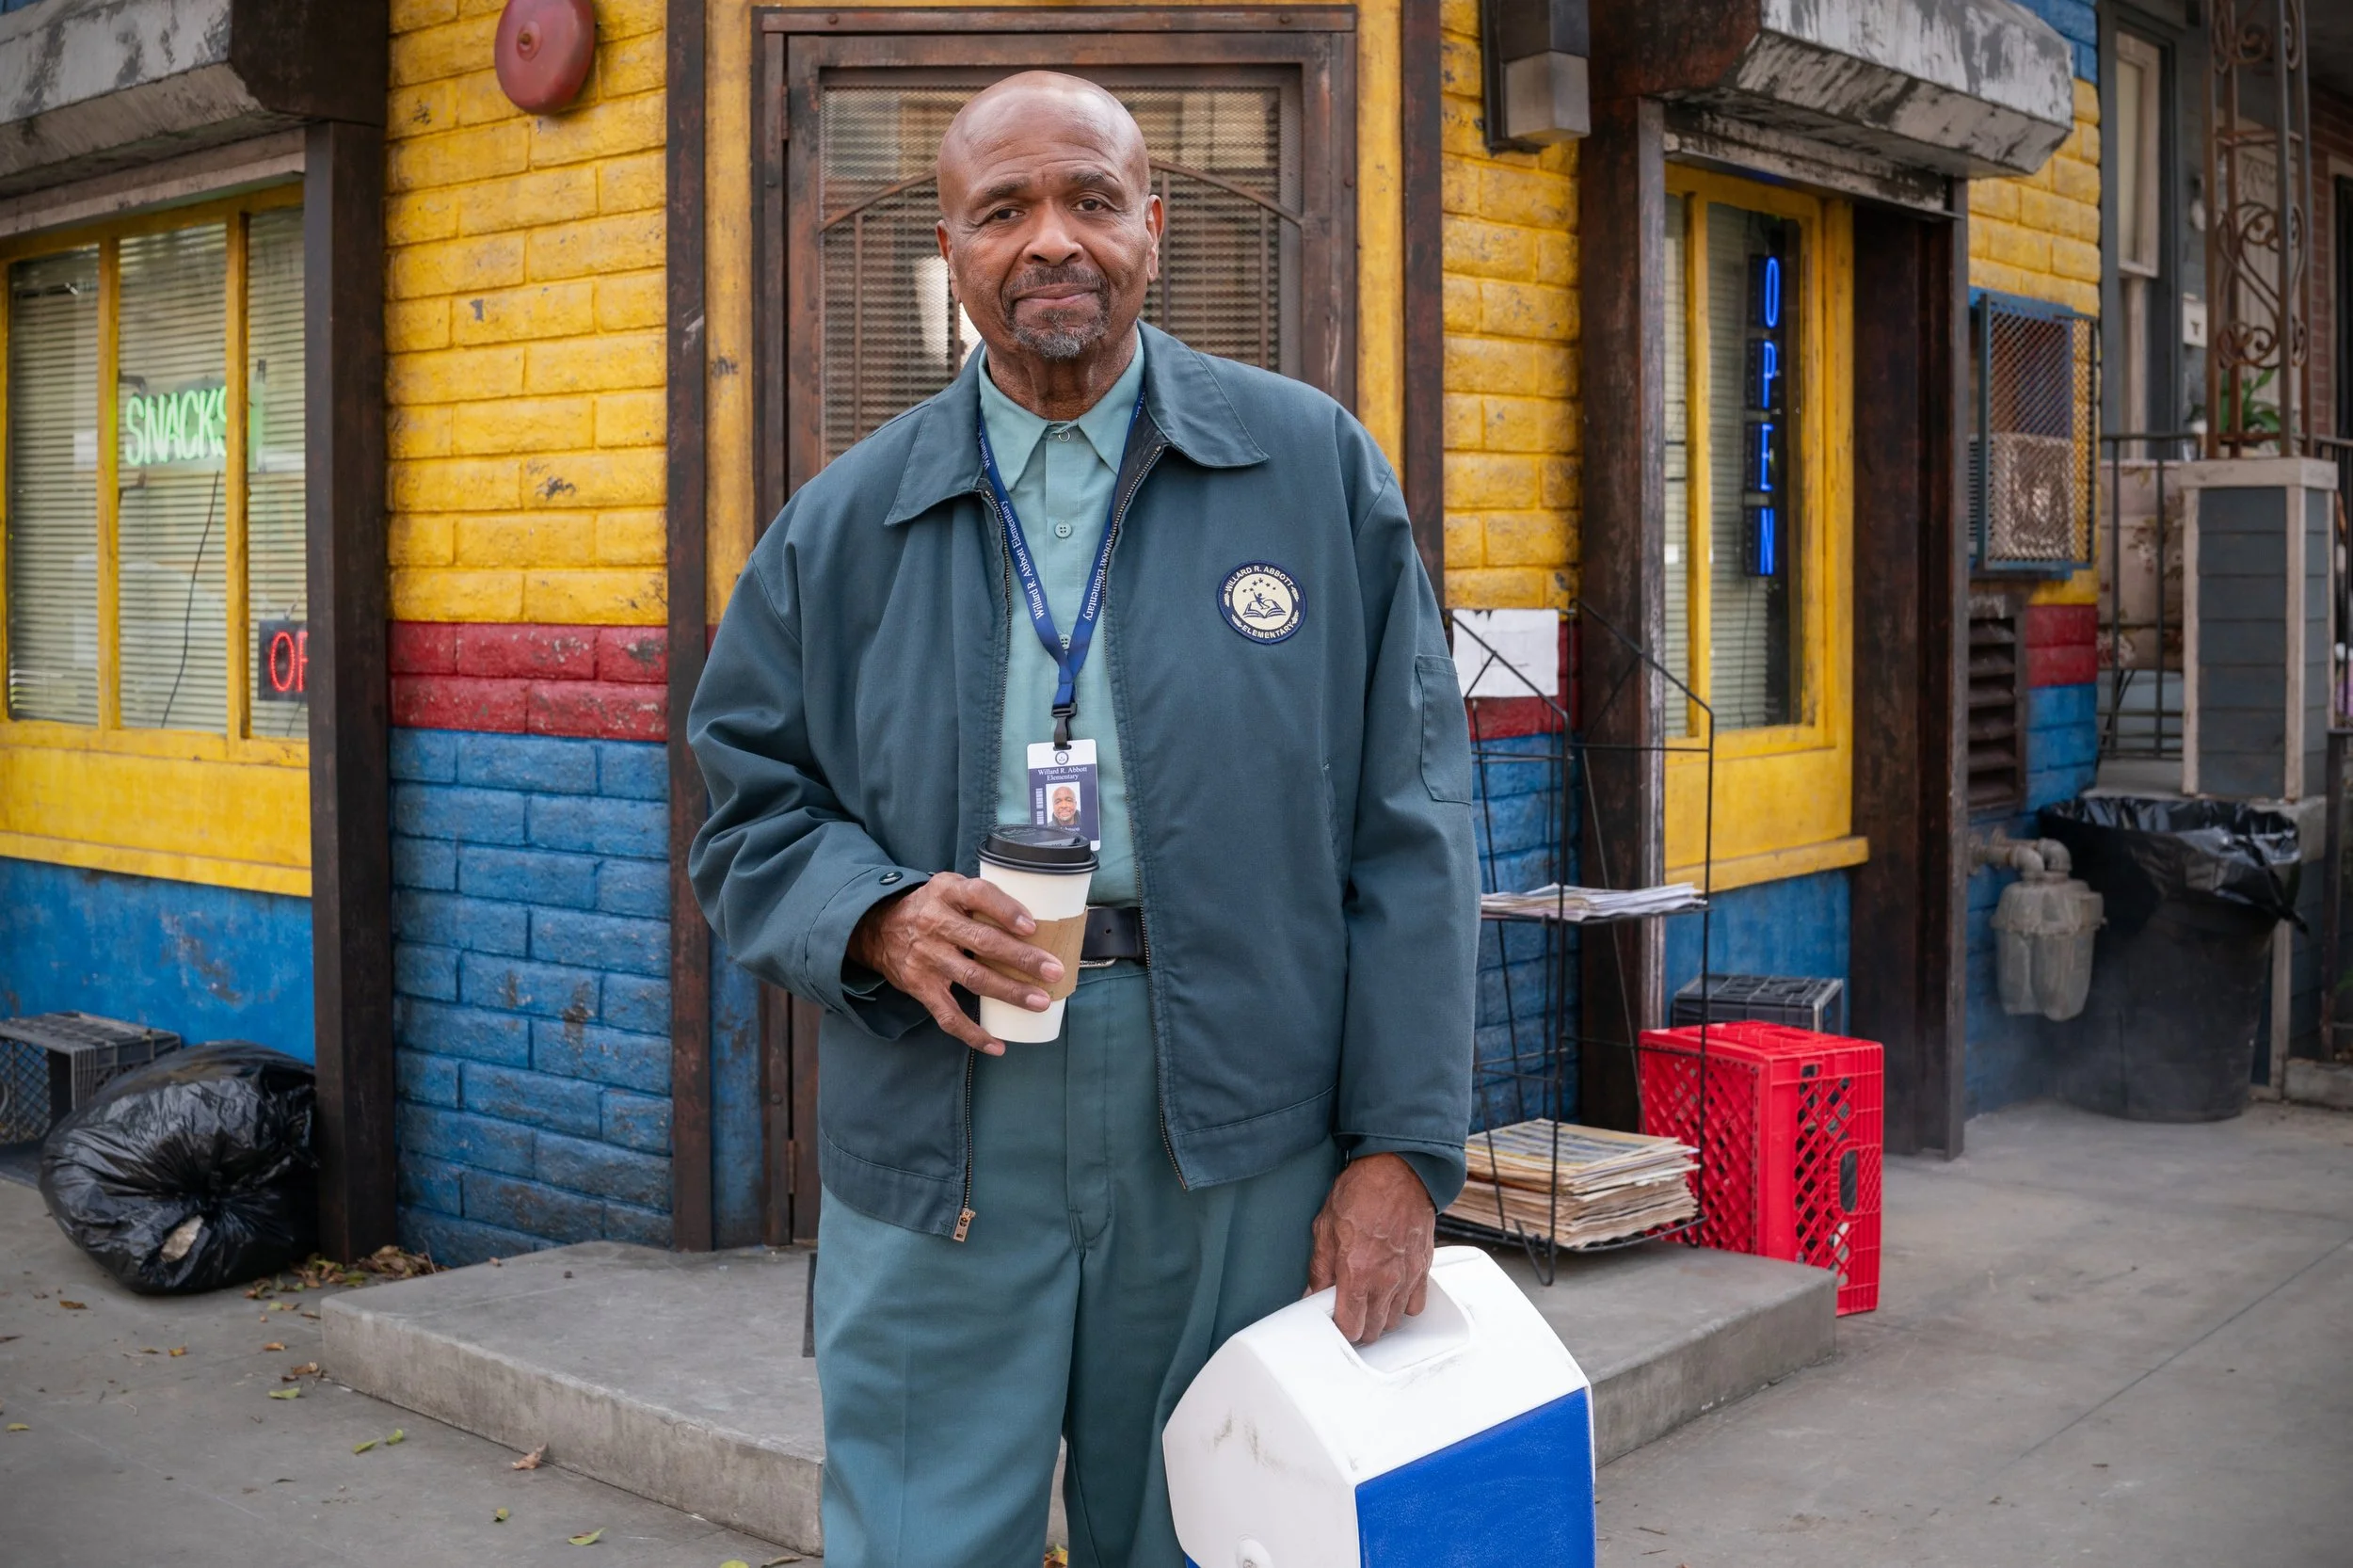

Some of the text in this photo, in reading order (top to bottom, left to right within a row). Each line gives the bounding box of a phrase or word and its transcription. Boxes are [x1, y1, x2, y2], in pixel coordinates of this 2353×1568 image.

[1759, 256, 1780, 576] OPEN
[1000, 501, 1045, 619] Willard R. Abbott Elementary
[1225, 568, 1252, 592] WILLARD
[1263, 567, 1294, 586] ABBOTT
[1082, 568, 1105, 621] Elementary
[1241, 622, 1294, 639] ELEMENTARY
